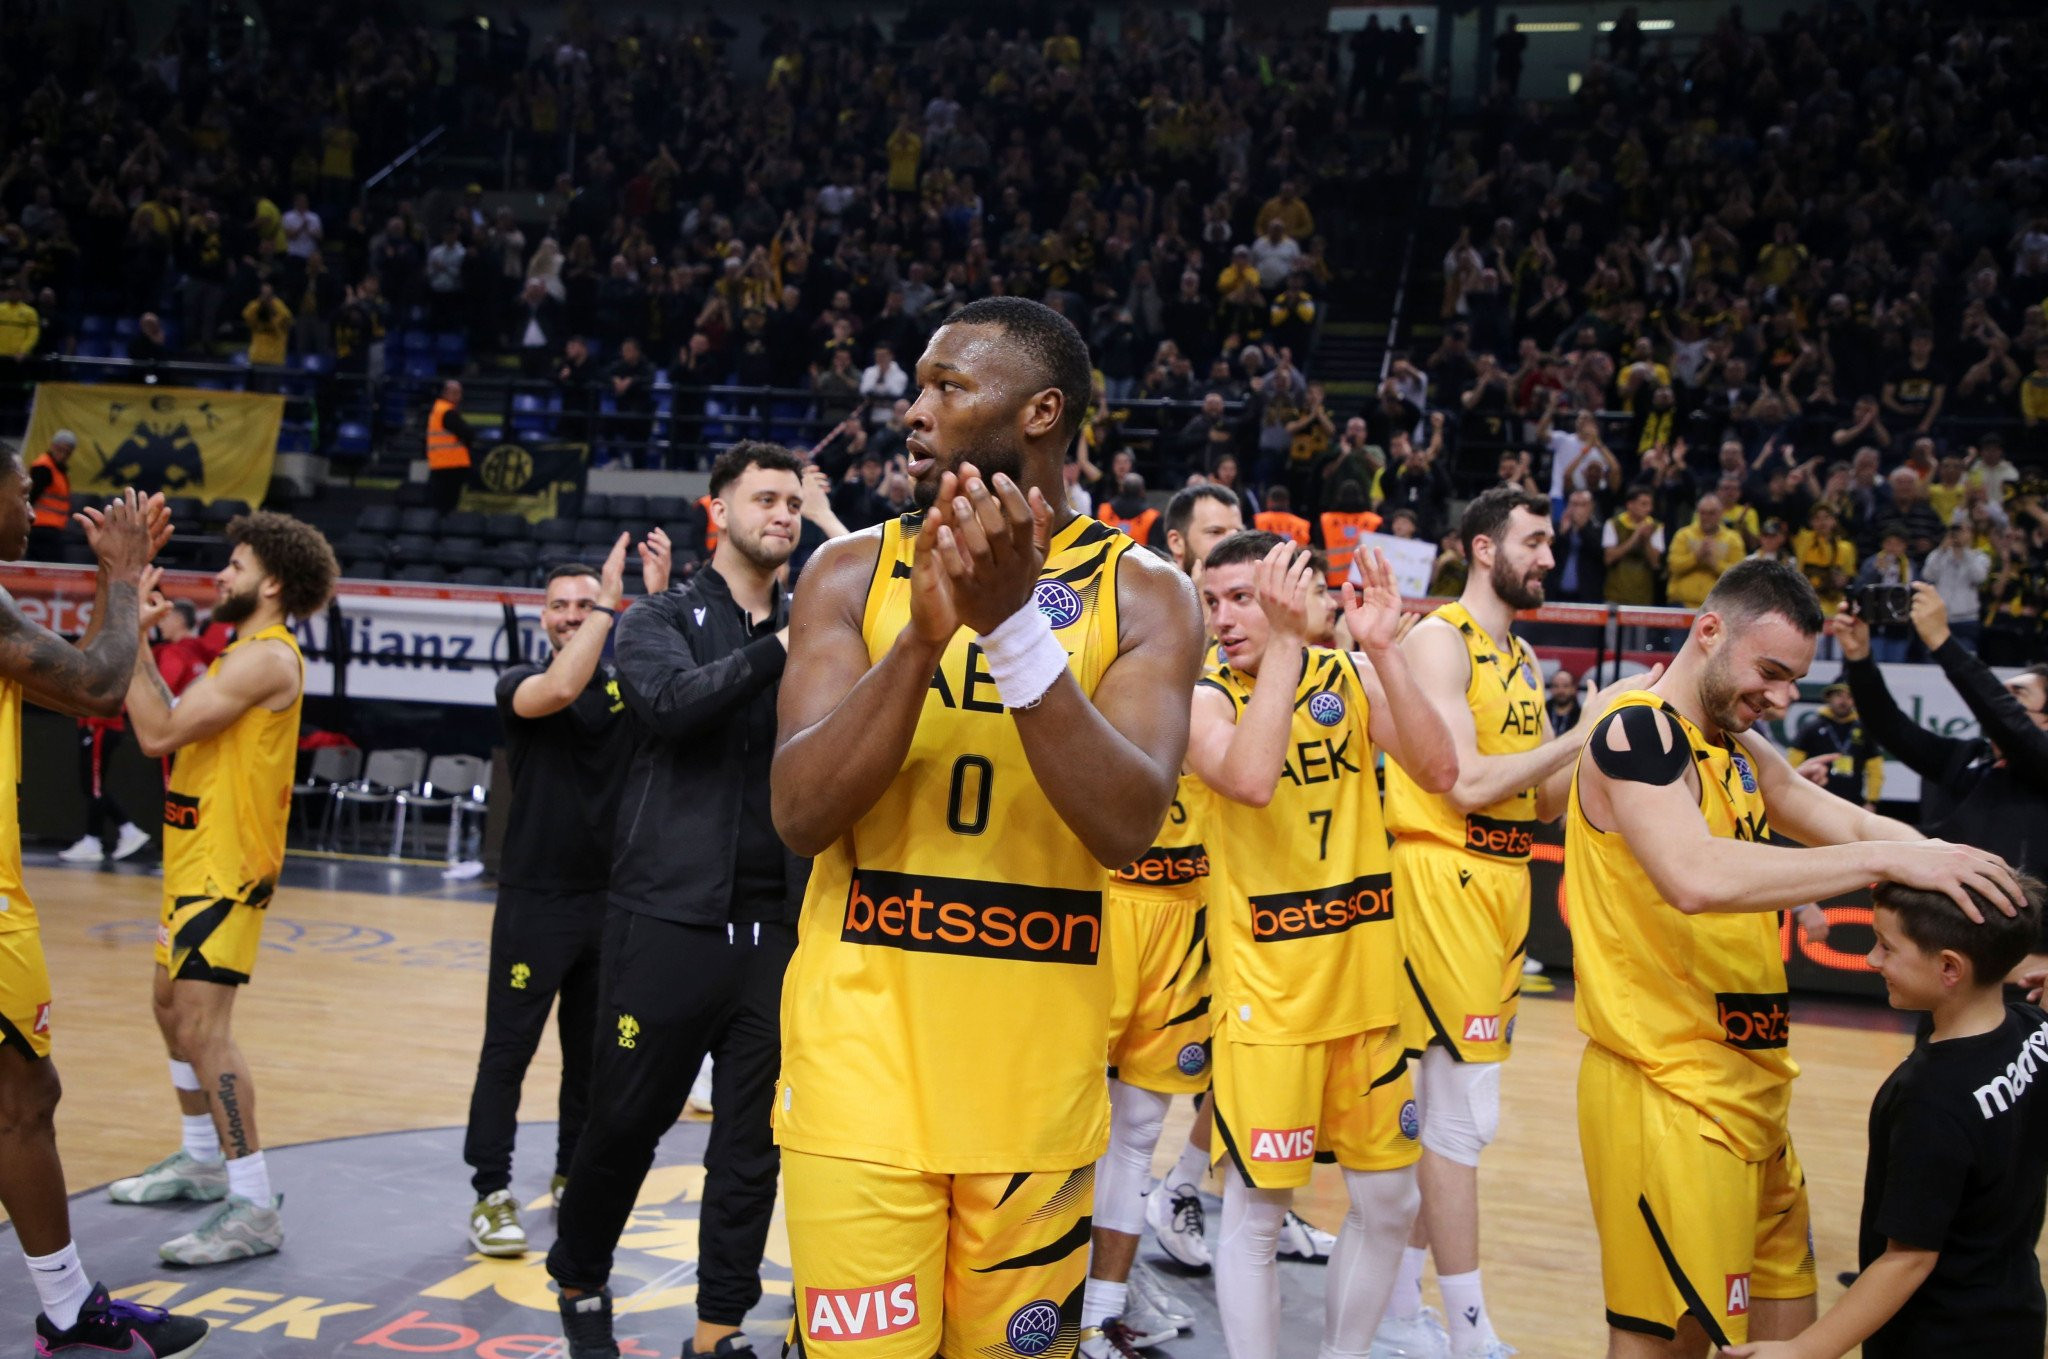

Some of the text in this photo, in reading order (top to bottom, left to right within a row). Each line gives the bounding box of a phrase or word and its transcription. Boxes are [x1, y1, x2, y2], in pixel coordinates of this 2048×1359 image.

[1501, 701, 1544, 736] AEK
[946, 753, 994, 837] 0
[1308, 808, 1333, 862] 7
[845, 879, 1100, 953] betsson
[1251, 1128, 1314, 1159] AVIS
[810, 1282, 916, 1336] AVIS
